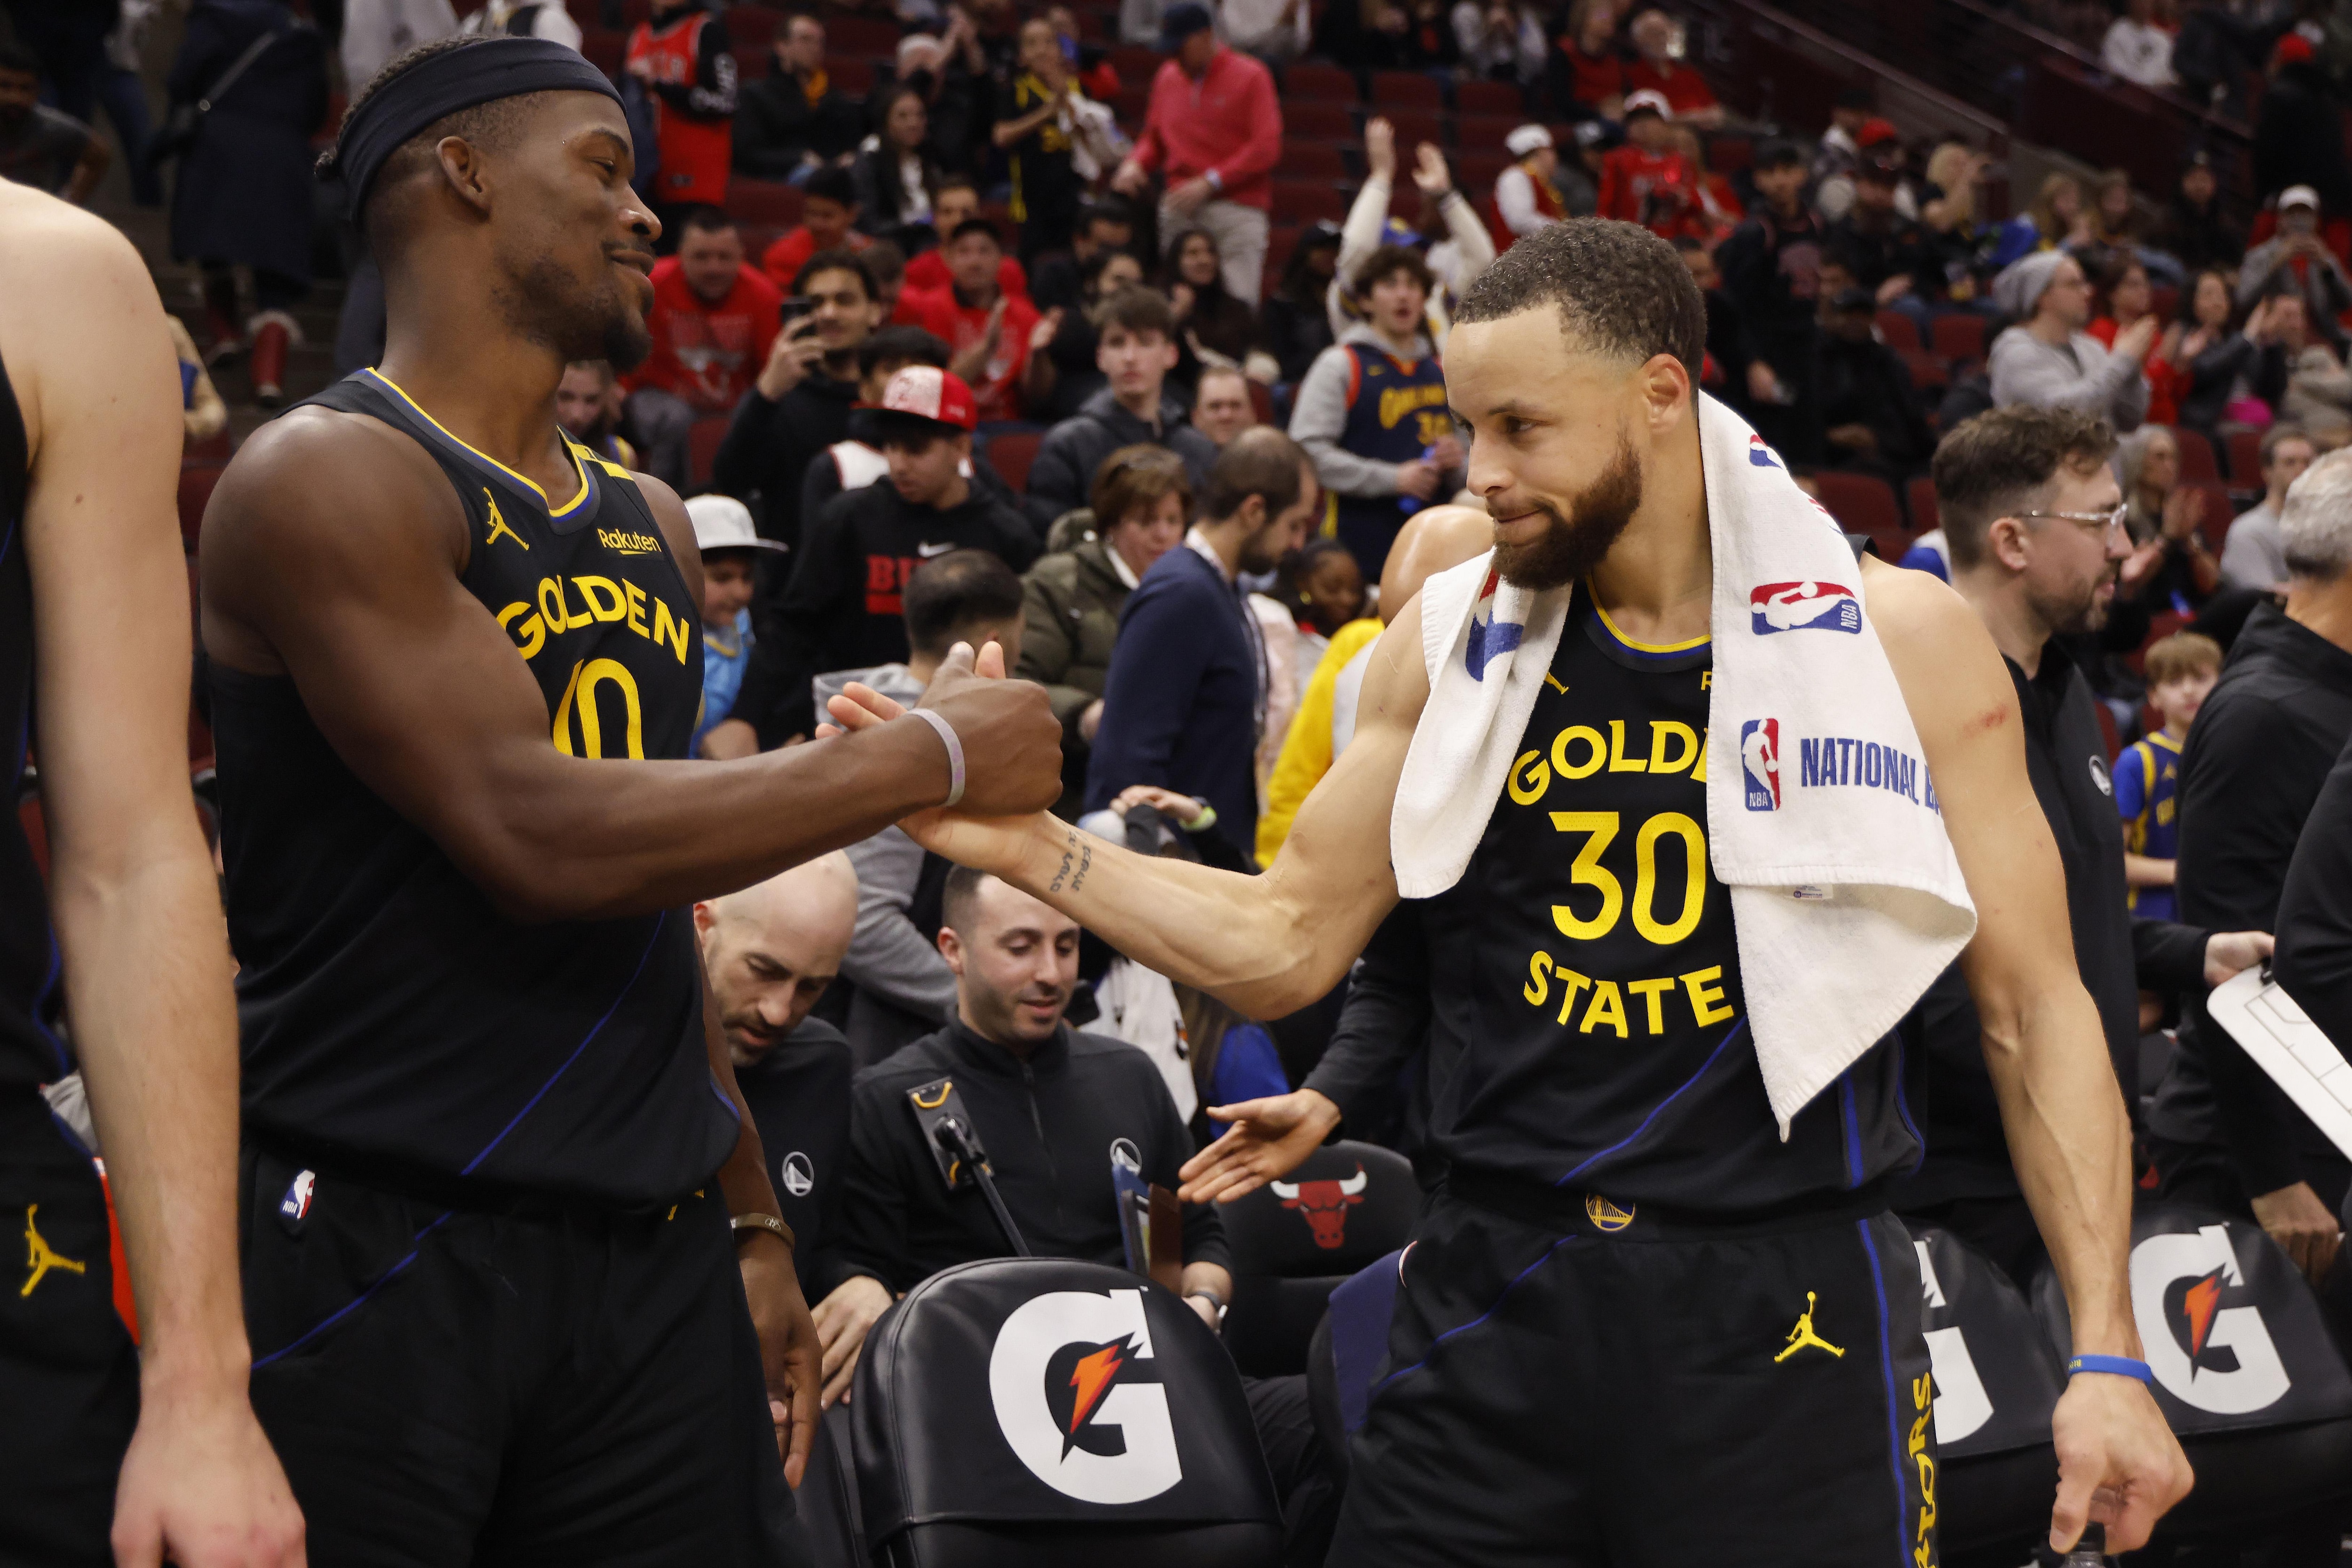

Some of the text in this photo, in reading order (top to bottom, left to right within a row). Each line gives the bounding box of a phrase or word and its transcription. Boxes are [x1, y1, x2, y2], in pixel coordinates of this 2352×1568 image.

[597, 528, 661, 553] Rakuten
[496, 575, 690, 666] GOLDEN
[1840, 604, 1858, 629] NBA
[1749, 792, 1768, 807] NBA
[1801, 738, 1919, 805] NATIONAL
[1549, 812, 1706, 945] 30
[1524, 950, 1734, 1039] STATE
[283, 1200, 298, 1214] NBA
[2129, 1224, 2292, 1415] G
[989, 1289, 1183, 1504] G
